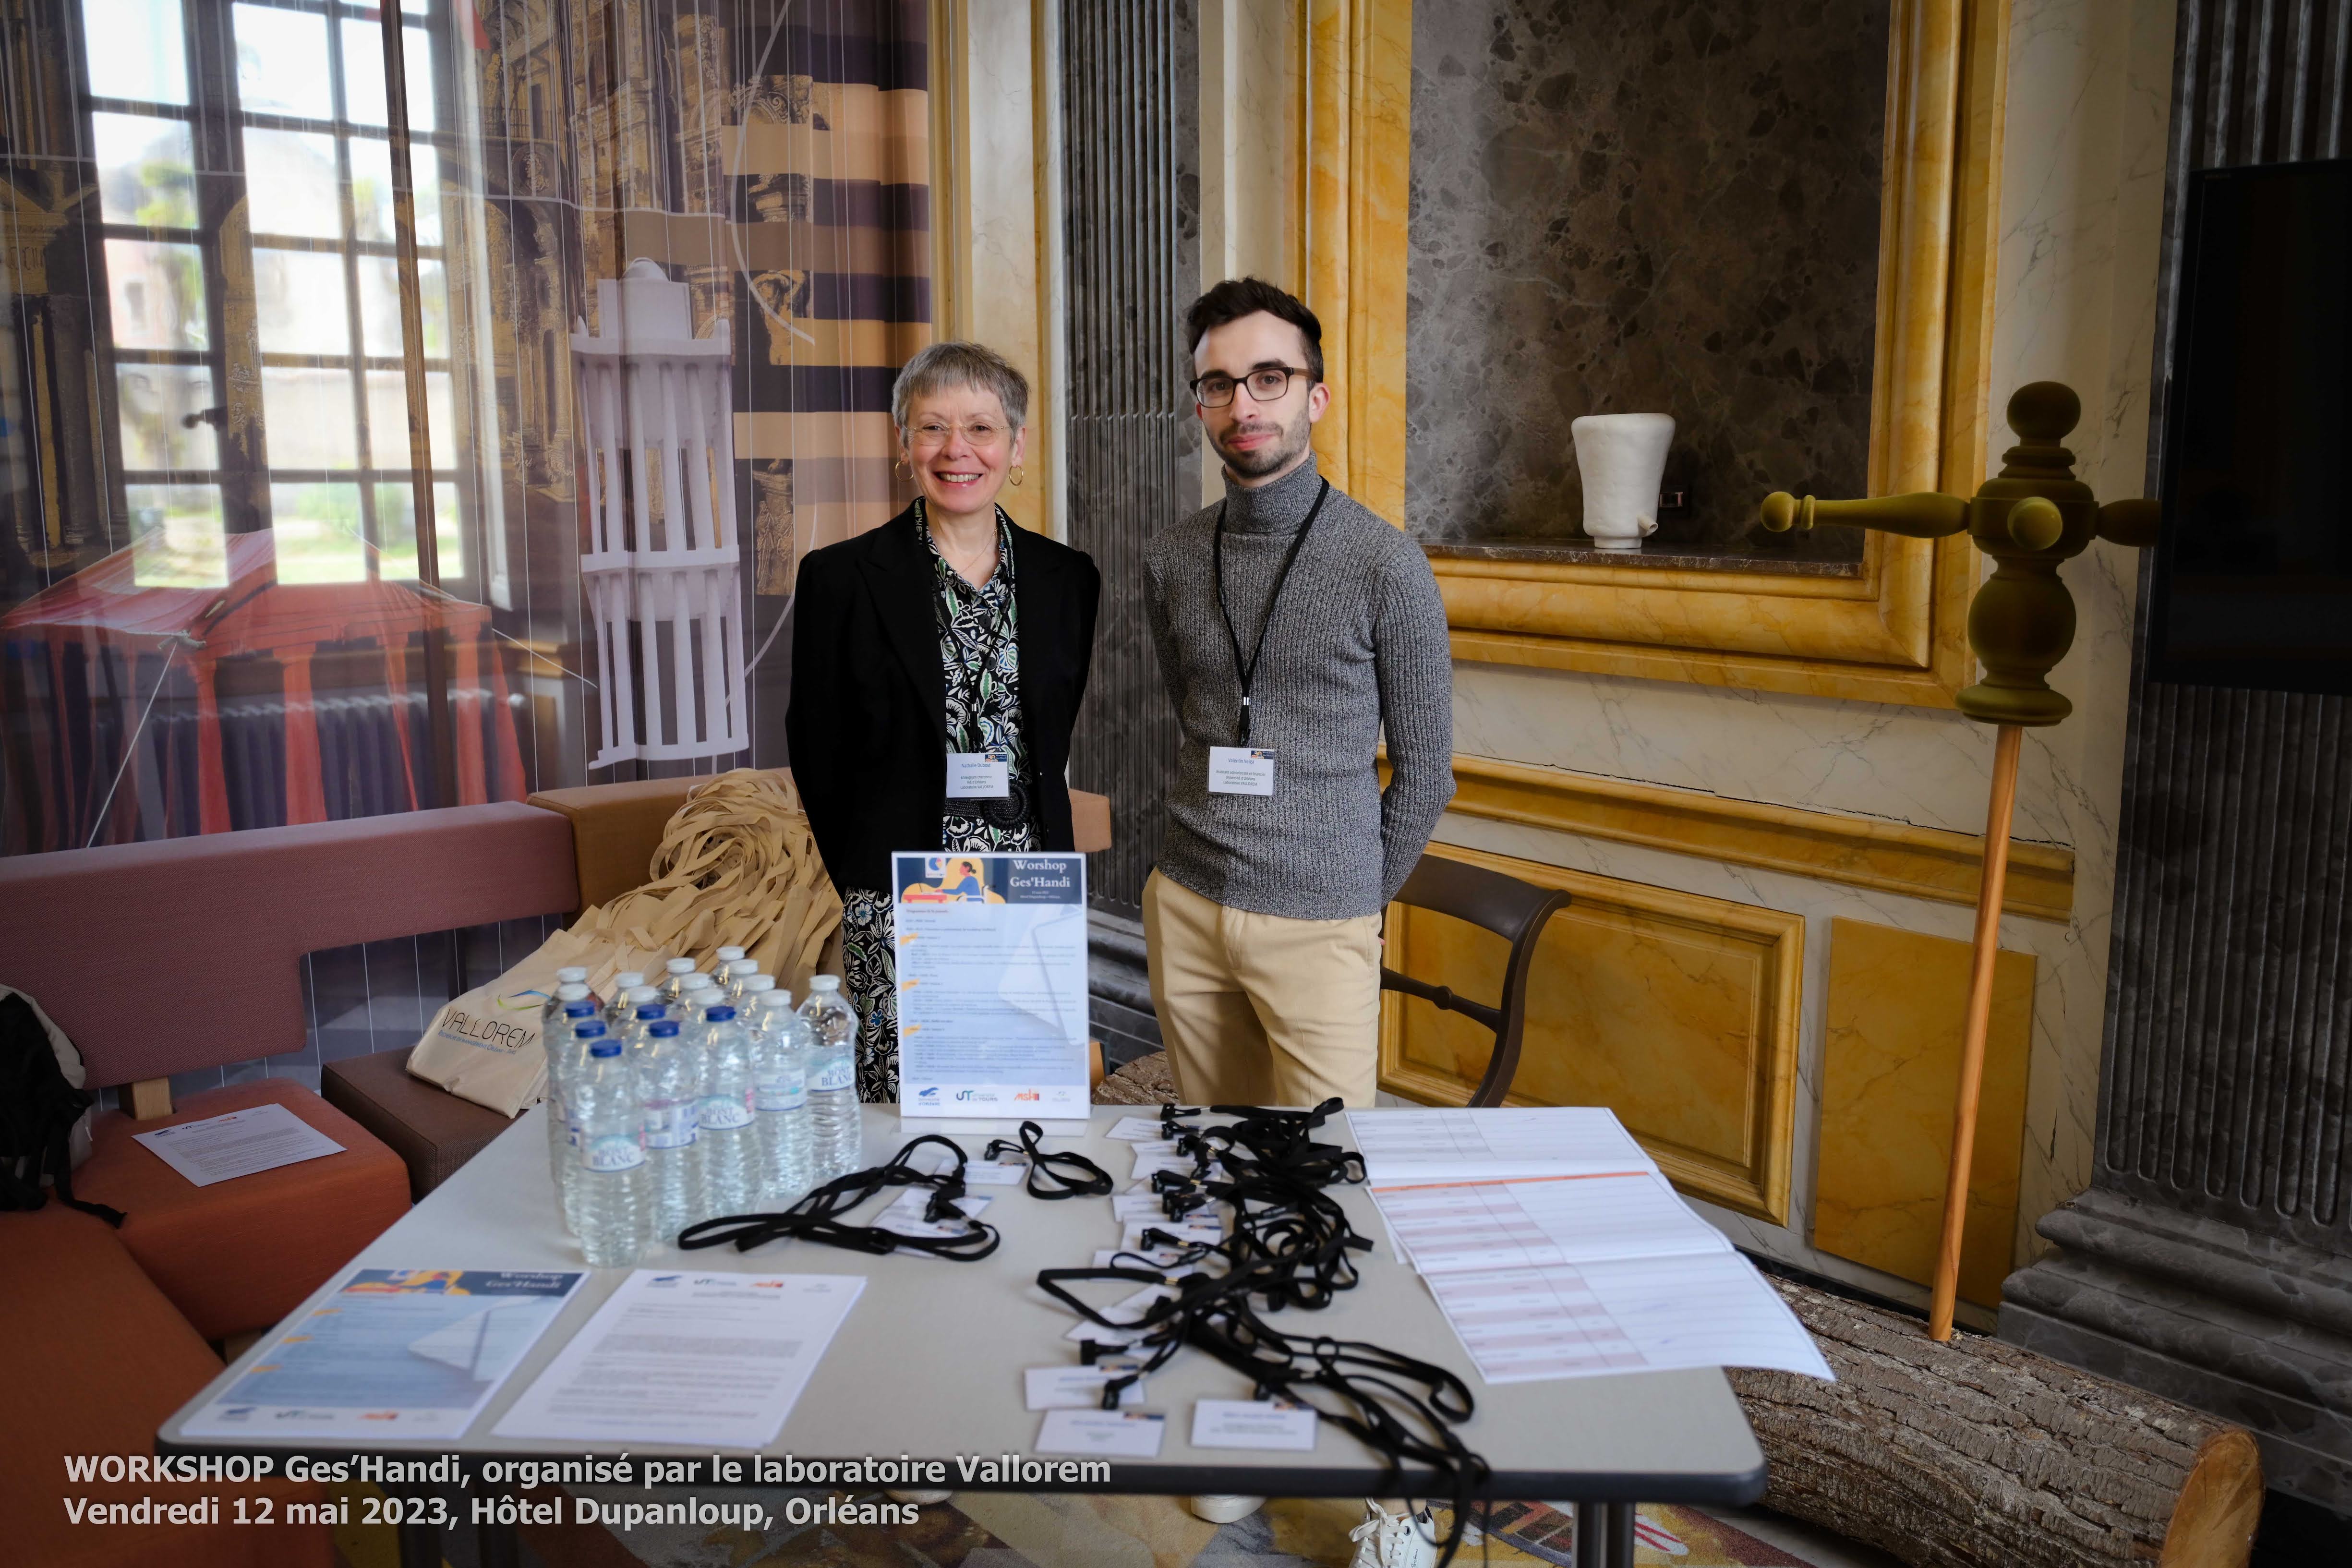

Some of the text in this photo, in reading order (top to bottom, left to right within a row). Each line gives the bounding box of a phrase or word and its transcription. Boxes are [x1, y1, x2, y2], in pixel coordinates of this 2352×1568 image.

[1013, 858, 1067, 874] Worshop
[1010, 876, 1071, 888] Ges'Handi
[442, 1009, 536, 1049] VALLOREM
[821, 1074, 853, 1086] BLANC
[700, 1113, 740, 1125] BLANC
